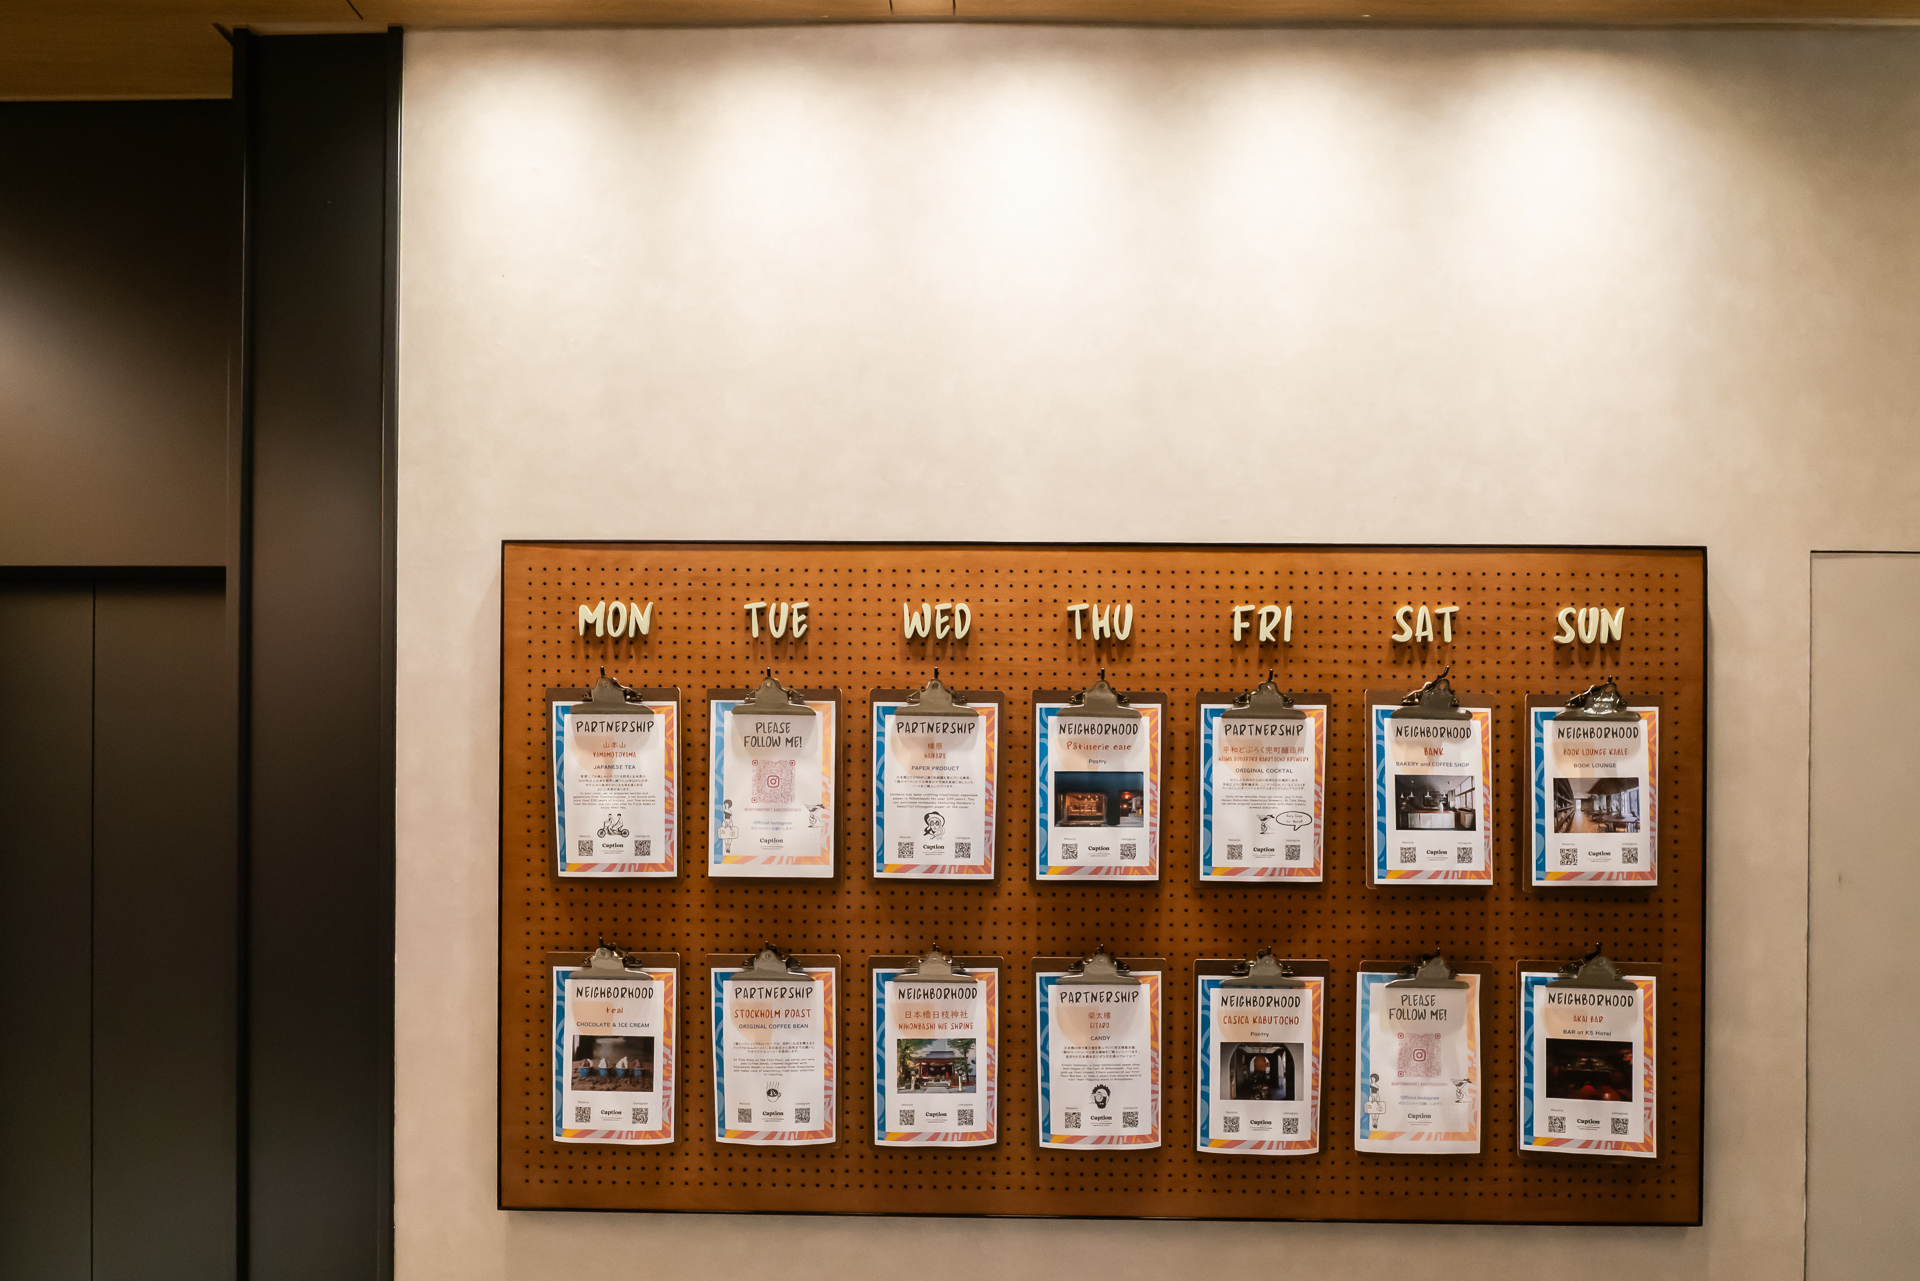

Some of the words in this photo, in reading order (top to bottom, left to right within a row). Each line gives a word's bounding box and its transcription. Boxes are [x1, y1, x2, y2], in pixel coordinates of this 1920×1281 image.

[578, 601, 653, 638] MON
[744, 602, 809, 639] TUE
[903, 602, 971, 640] WED
[1067, 603, 1134, 641] THU
[1232, 604, 1292, 642] FRI
[1391, 605, 1460, 643] SAT
[1553, 607, 1625, 644] SUN
[576, 720, 654, 733] PARTNERSHIP
[755, 721, 791, 734] PLEASE
[896, 721, 975, 734] PARTNERSHIP
[1059, 723, 1139, 736] NEIGHBORHOOD
[1224, 724, 1304, 736] PARTNERSHIP
[1395, 725, 1472, 739] NEIGHBORHOOD
[1558, 727, 1639, 739] NEIGHBORHOOD
[743, 735, 781, 748] FOLLOW
[785, 736, 803, 748] ME!
[1424, 747, 1444, 756] BANK
[1563, 748, 1580, 756] BOOK
[1581, 748, 1606, 756] LOUNGE
[1609, 748, 1628, 756] KABLE
[576, 986, 654, 999] NEIGHBORHOOD
[734, 987, 813, 999] PARTNERSHIP
[898, 987, 978, 1000] NEIGHBORHOOD
[1060, 991, 1139, 1003] PARTNERSHIP
[1221, 995, 1301, 1008] NEIGHBORHOOD
[1400, 994, 1436, 1007] PLEASE
[1548, 992, 1634, 1008] NEIGHBORHOOD
[734, 1008, 781, 1019] STOCKHOLM
[784, 1008, 812, 1018] ROAST
[904, 1010, 969, 1019] 日本橋日枝神社
[1223, 1015, 1250, 1025] CASICA
[1252, 1015, 1300, 1025] KABUTOCHO
[1388, 1008, 1427, 1021] FOLLOW
[1430, 1008, 1447, 1021] ME!
[1573, 1015, 1588, 1023] AKAI
[1589, 1015, 1604, 1023] BAR
[950, 1022, 974, 1030] SHRINE
